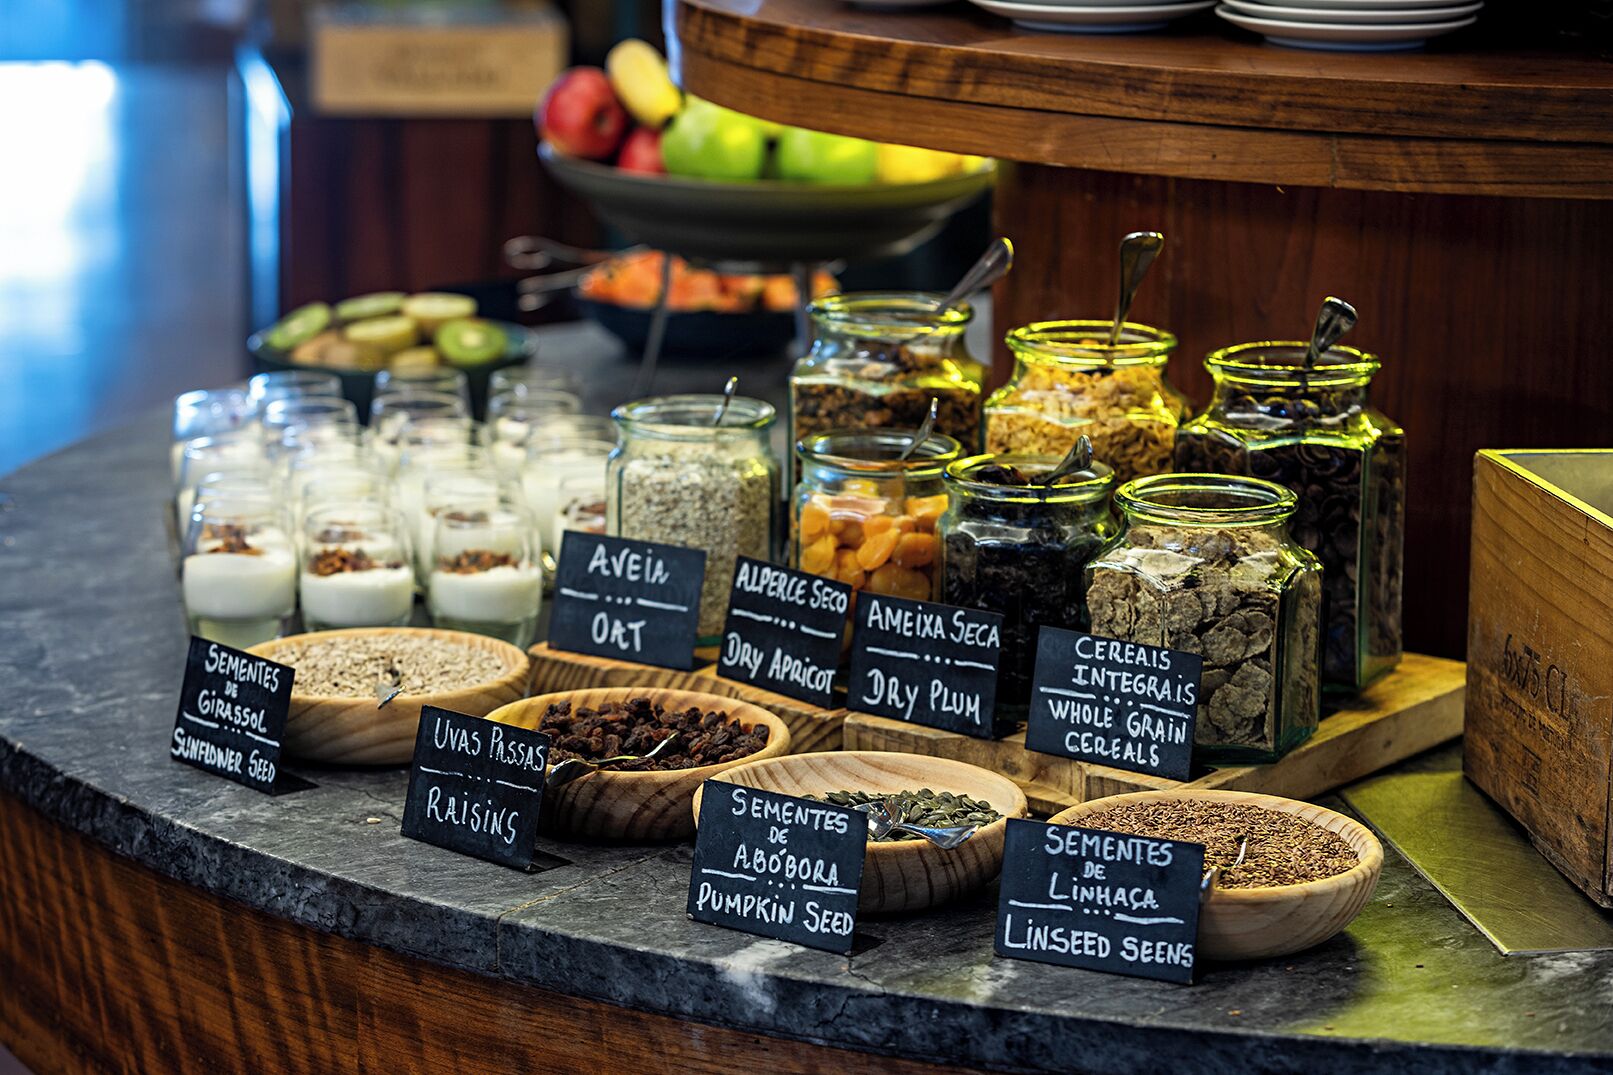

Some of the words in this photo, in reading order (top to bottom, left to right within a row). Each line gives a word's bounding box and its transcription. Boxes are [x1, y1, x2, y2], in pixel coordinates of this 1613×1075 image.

[735, 562, 808, 605] ALPERCE
[809, 579, 848, 614] SECO
[591, 611, 647, 653] OAT
[950, 610, 1001, 648] SECA
[205, 643, 280, 693] SEMENTES
[722, 631, 764, 679] DRY
[224, 680, 238, 699] DE
[862, 668, 919, 720] DRY
[930, 678, 981, 725] PLUM
[1048, 698, 1113, 729] WHOLE
[171, 727, 242, 774] SUNFLOWER
[248, 749, 276, 783] SEED
[434, 717, 481, 756] UVAS
[489, 726, 545, 772] PASSAS
[1065, 731, 1160, 767] CEREALS
[731, 788, 849, 834] SEMENTES
[768, 826, 789, 844] DE
[1044, 825, 1174, 867] SEMENTES
[733, 844, 839, 886] ABÓBORA
[1083, 861, 1106, 880] DE
[803, 901, 854, 936] SEED
[1120, 936, 1194, 968] SEENS
